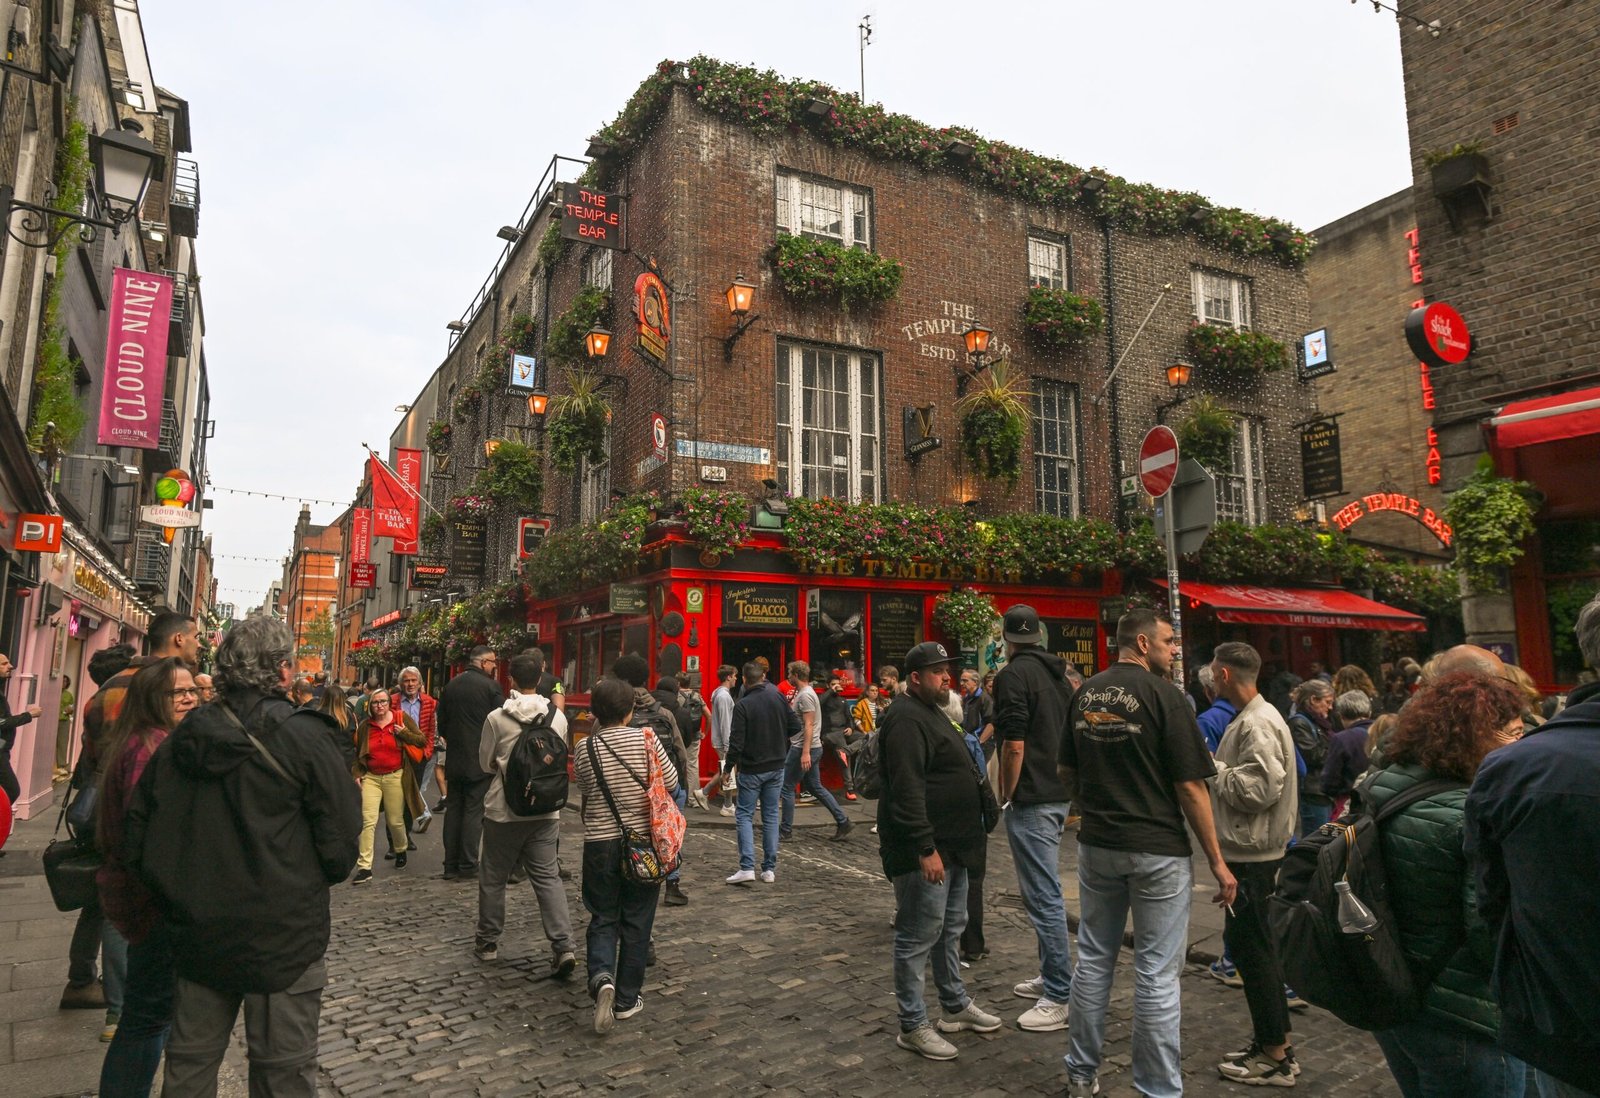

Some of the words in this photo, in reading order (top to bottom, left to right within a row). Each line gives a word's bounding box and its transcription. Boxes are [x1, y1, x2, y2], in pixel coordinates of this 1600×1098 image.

[580, 191, 606, 207] THE
[566, 204, 619, 225] TEMPLE
[579, 224, 606, 239] BAR
[121, 277, 160, 334] NINE
[941, 300, 975, 320] THE
[921, 343, 959, 361] ESTD.
[113, 342, 148, 421] CLOUD
[133, 430, 148, 438] NINE
[1304, 430, 1336, 441] TEMPLE
[1311, 440, 1329, 449] BAR
[150, 508, 174, 516] CLOUD
[176, 510, 193, 518] NINE
[1332, 501, 1364, 530] THE
[1362, 493, 1420, 516] TEMPLE
[1422, 508, 1453, 545] BAR
[21, 521, 55, 544] PI
[387, 521, 405, 529] BAR
[455, 522, 485, 531] TEMPLE
[462, 530, 479, 538] BAR
[734, 600, 788, 620] TOBACCO
[1289, 614, 1305, 622] THE
[1076, 640, 1093, 651] THE
[1083, 665, 1092, 677] OF
[1078, 688, 1112, 711] Sean
[1105, 686, 1140, 713] John
